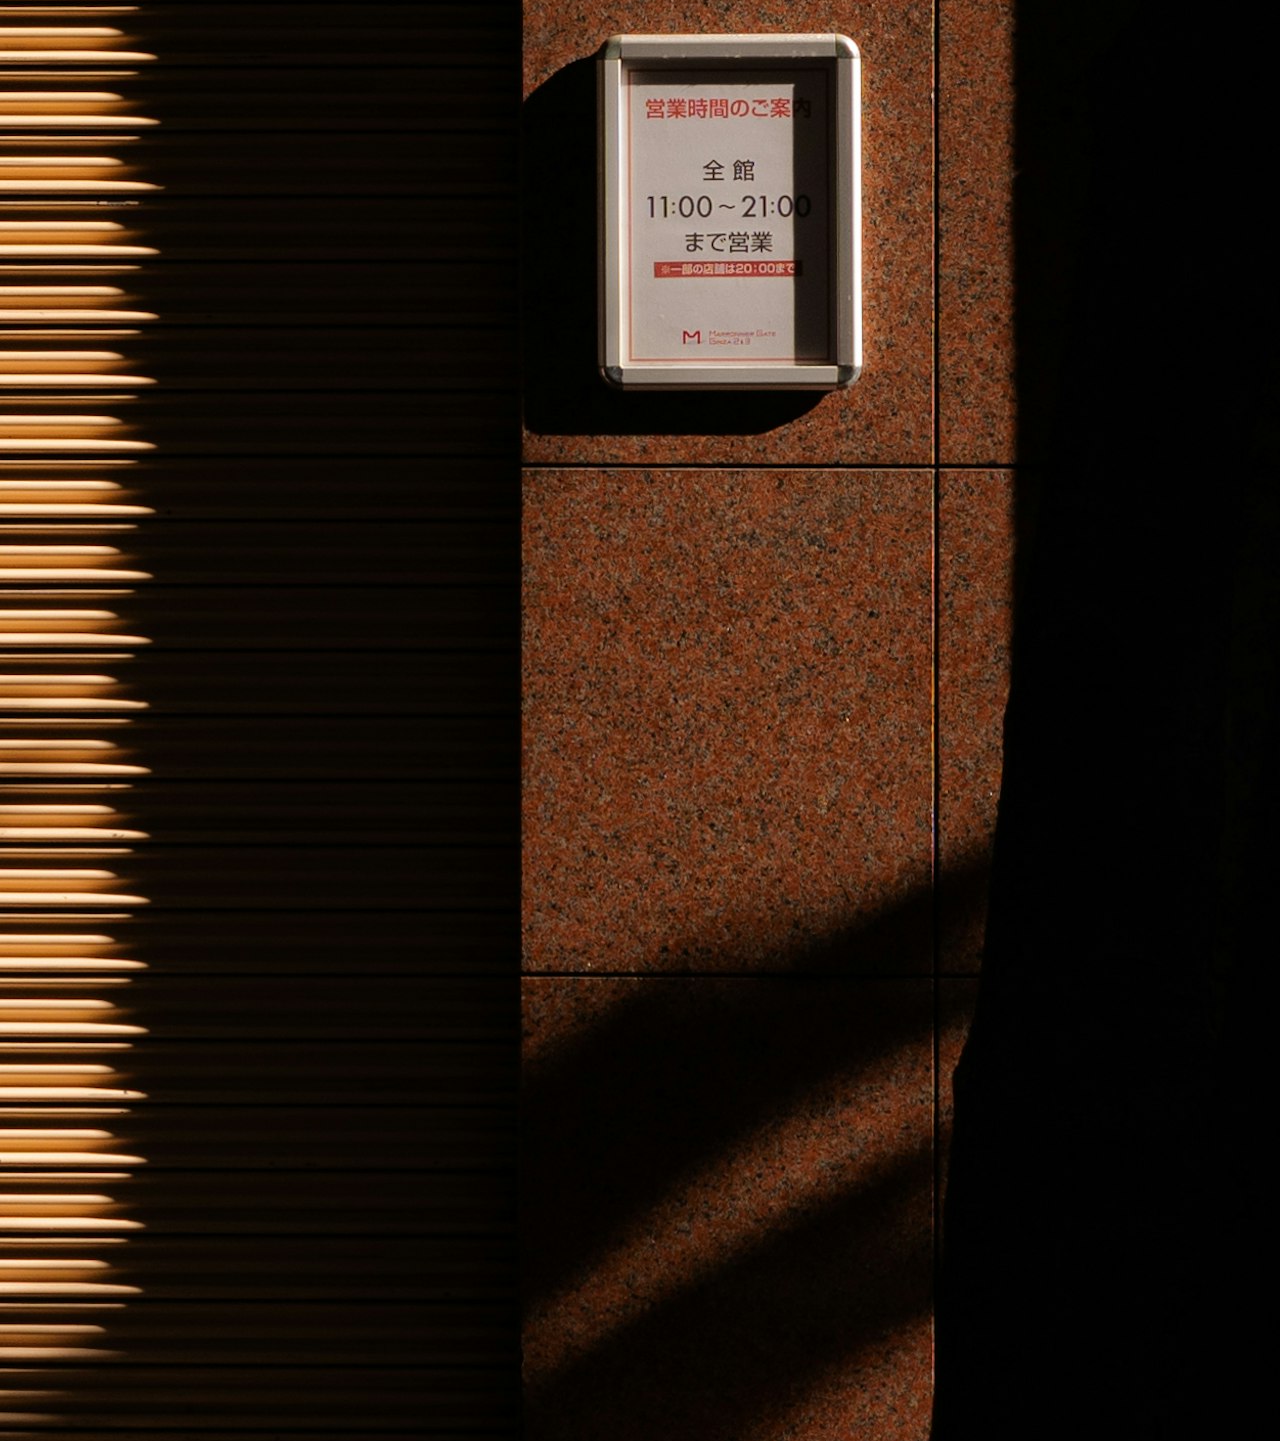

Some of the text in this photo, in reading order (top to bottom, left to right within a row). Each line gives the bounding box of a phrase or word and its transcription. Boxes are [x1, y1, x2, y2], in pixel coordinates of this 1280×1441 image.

[645, 98, 811, 119] 営業時間のご案内
[685, 231, 773, 252] まで営業
